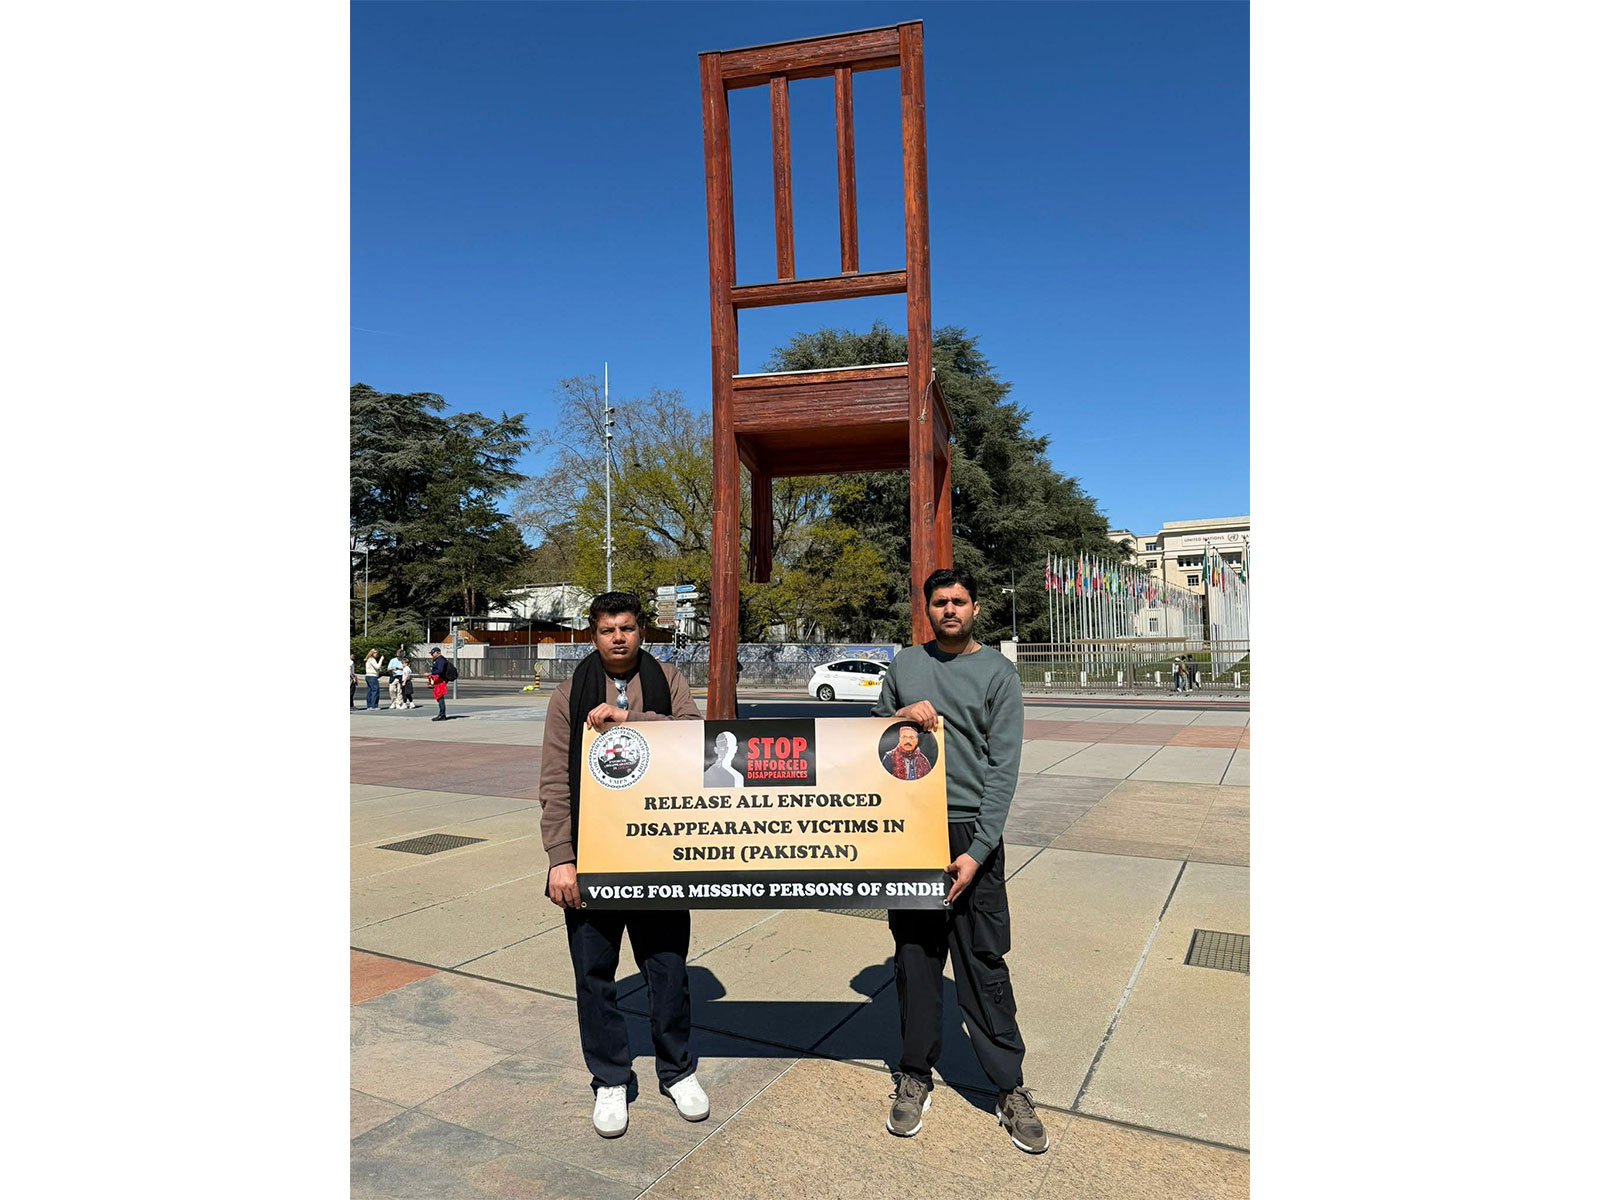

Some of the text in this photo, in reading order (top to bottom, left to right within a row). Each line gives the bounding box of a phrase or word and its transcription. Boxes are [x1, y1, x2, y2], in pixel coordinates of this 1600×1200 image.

[747, 736, 807, 759] STOP
[747, 759, 808, 771] ENFORCED
[747, 771, 808, 779] DISAPPEARANCES
[644, 793, 882, 811] RELEASE ALL ENFORCED
[625, 819, 905, 837] DISAPPEARANCE VICTIMS IN
[672, 844, 858, 863] SINDH (PAKISTAN)
[587, 882, 946, 900] VOICE FOR MISSING PERSONS OF SINDH
